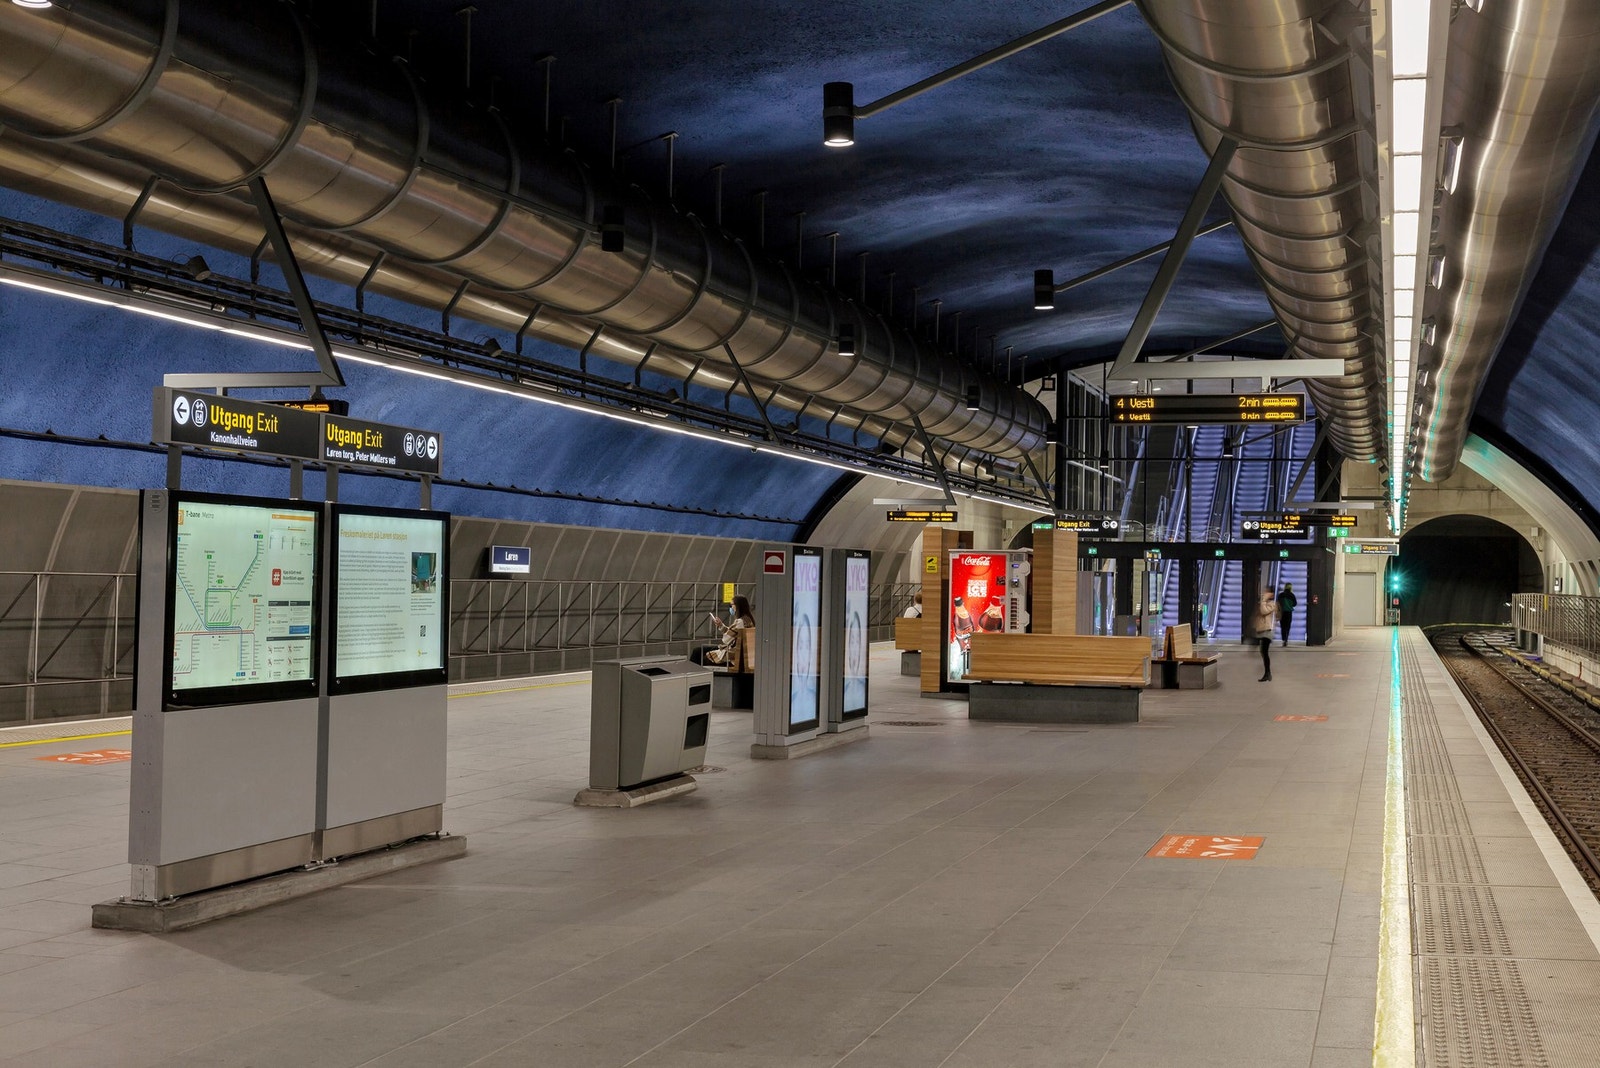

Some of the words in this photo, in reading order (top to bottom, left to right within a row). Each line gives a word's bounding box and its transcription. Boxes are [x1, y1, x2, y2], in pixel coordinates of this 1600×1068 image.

[1117, 398, 1124, 408] 4
[1129, 398, 1155, 408] Vestli
[210, 404, 254, 437] Utgang
[257, 412, 279, 434] Exit
[210, 431, 258, 447] Kanonhallveien
[326, 423, 363, 449] Utgang
[364, 430, 383, 448] Exit
[326, 447, 342, 459] Løren
[342, 449, 355, 462] torg,
[355, 450, 369, 462] Peter
[369, 453, 388, 464] Møllers
[388, 455, 397, 465] vei
[1057, 520, 1078, 528] Utgang
[1079, 520, 1091, 528] Exit
[505, 551, 519, 561] Løren
[848, 564, 866, 592] LYKO
